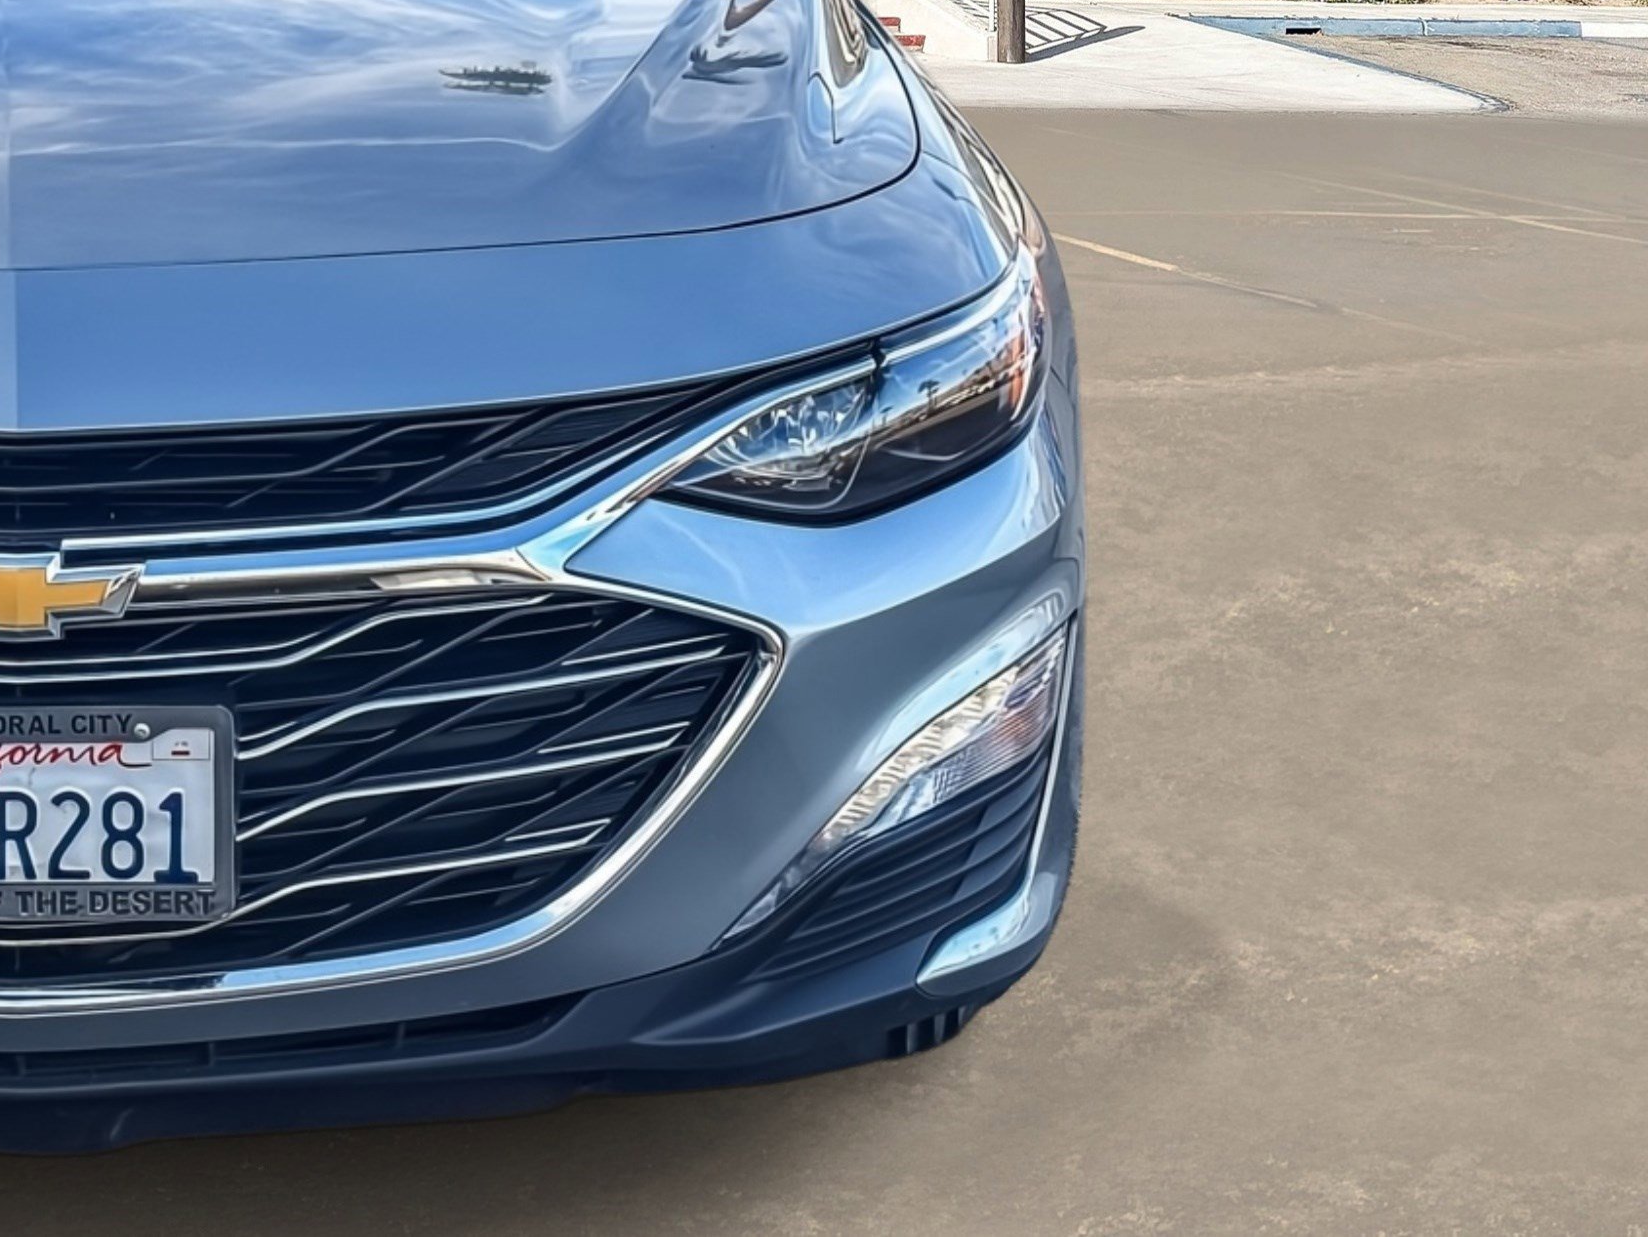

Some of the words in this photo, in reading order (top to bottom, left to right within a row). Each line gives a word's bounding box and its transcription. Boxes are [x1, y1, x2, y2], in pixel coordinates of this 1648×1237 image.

[70, 713, 135, 736] CITY
[14, 891, 87, 916] THE
[88, 889, 218, 917] DESERT
